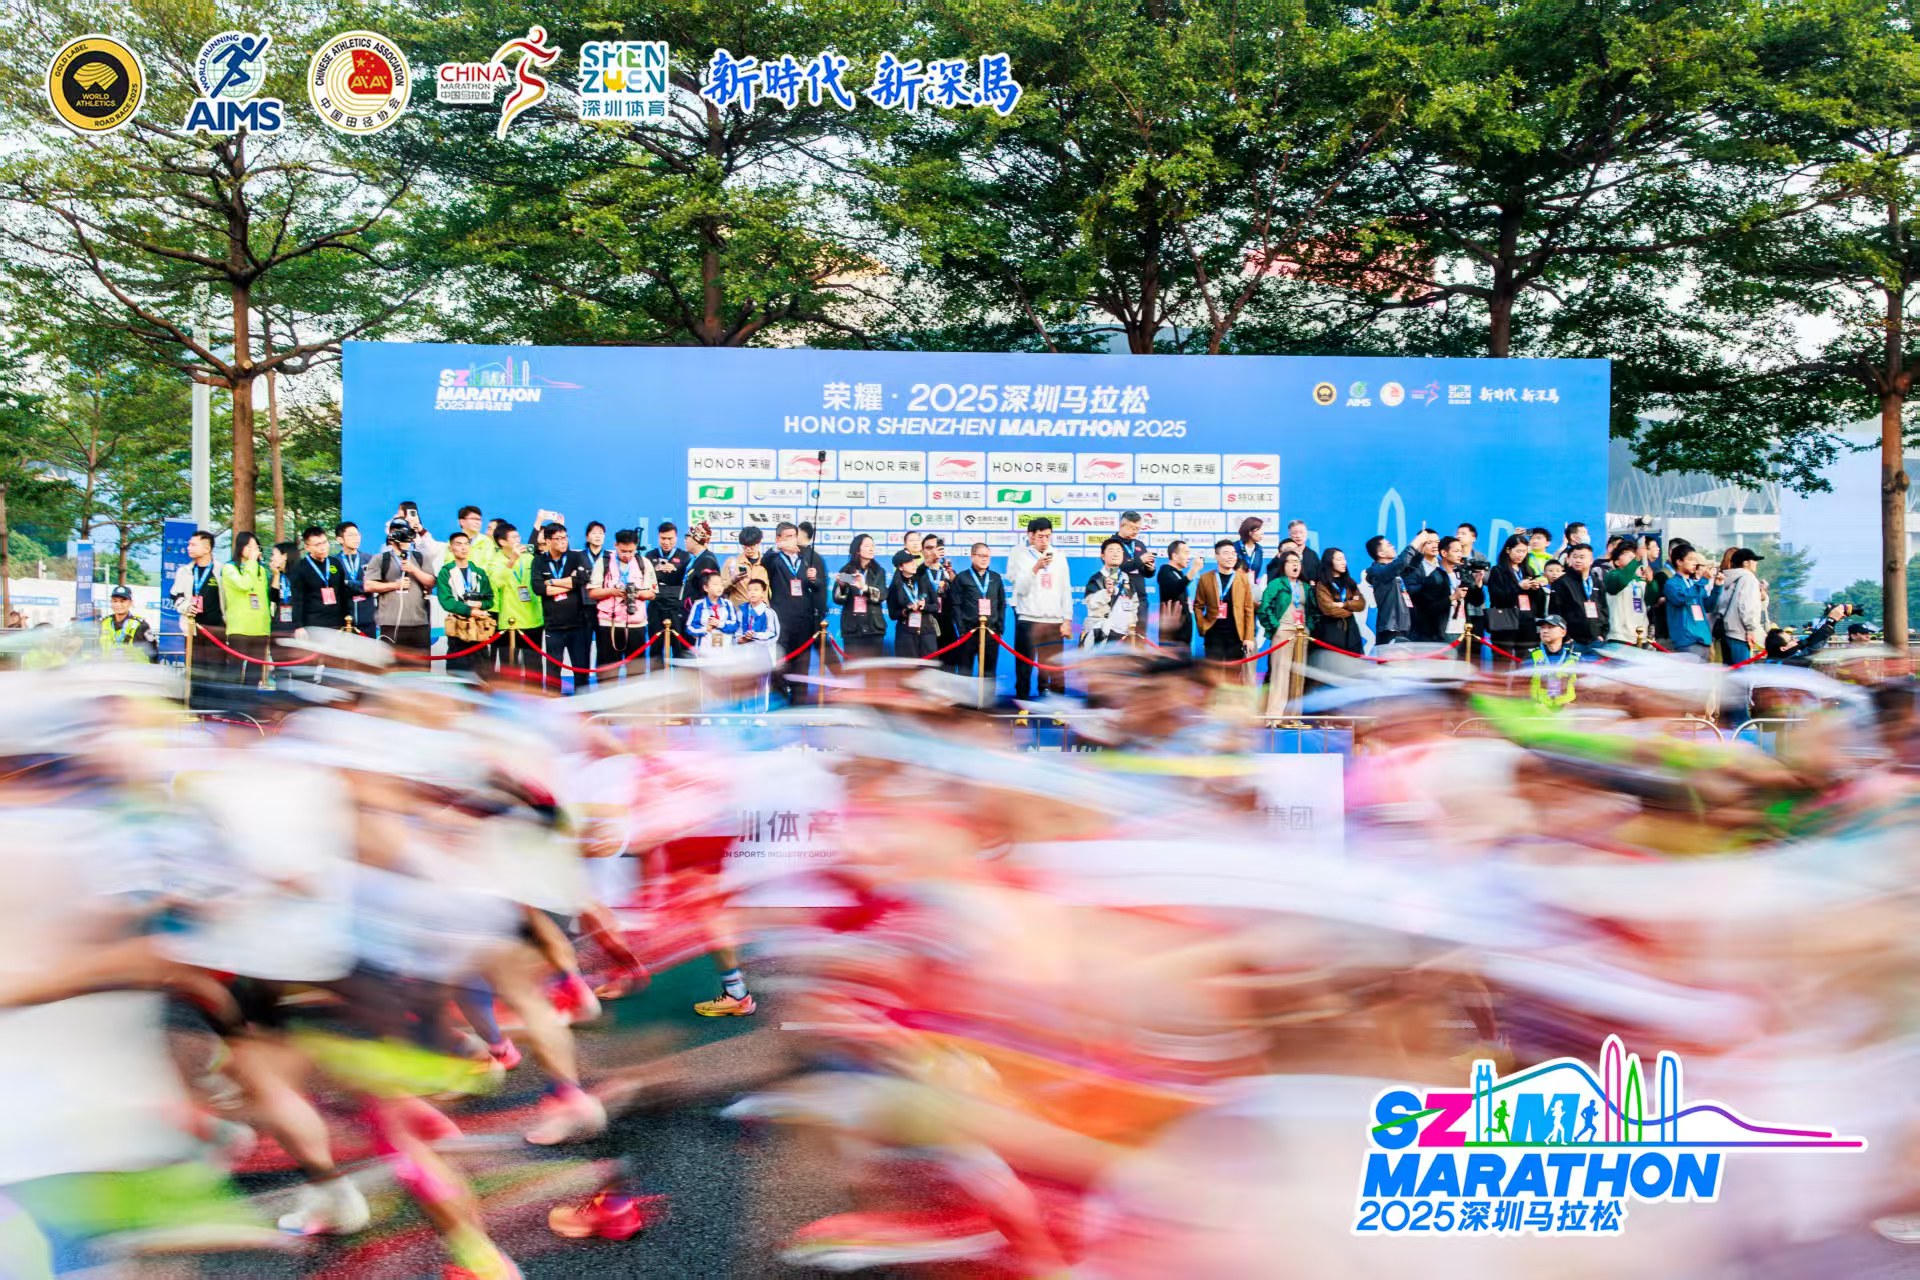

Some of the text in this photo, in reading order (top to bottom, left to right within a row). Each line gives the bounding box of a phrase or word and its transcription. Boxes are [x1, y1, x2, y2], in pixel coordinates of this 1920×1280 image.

[436, 387, 542, 402] MARATHON
[784, 415, 1187, 438] HONOR SHENZHEN MARATHON 2025
[694, 458, 745, 470] HONOR
[844, 460, 894, 472] HONOR
[993, 462, 1043, 473] HONOR
[1140, 463, 1190, 475] HONOR
